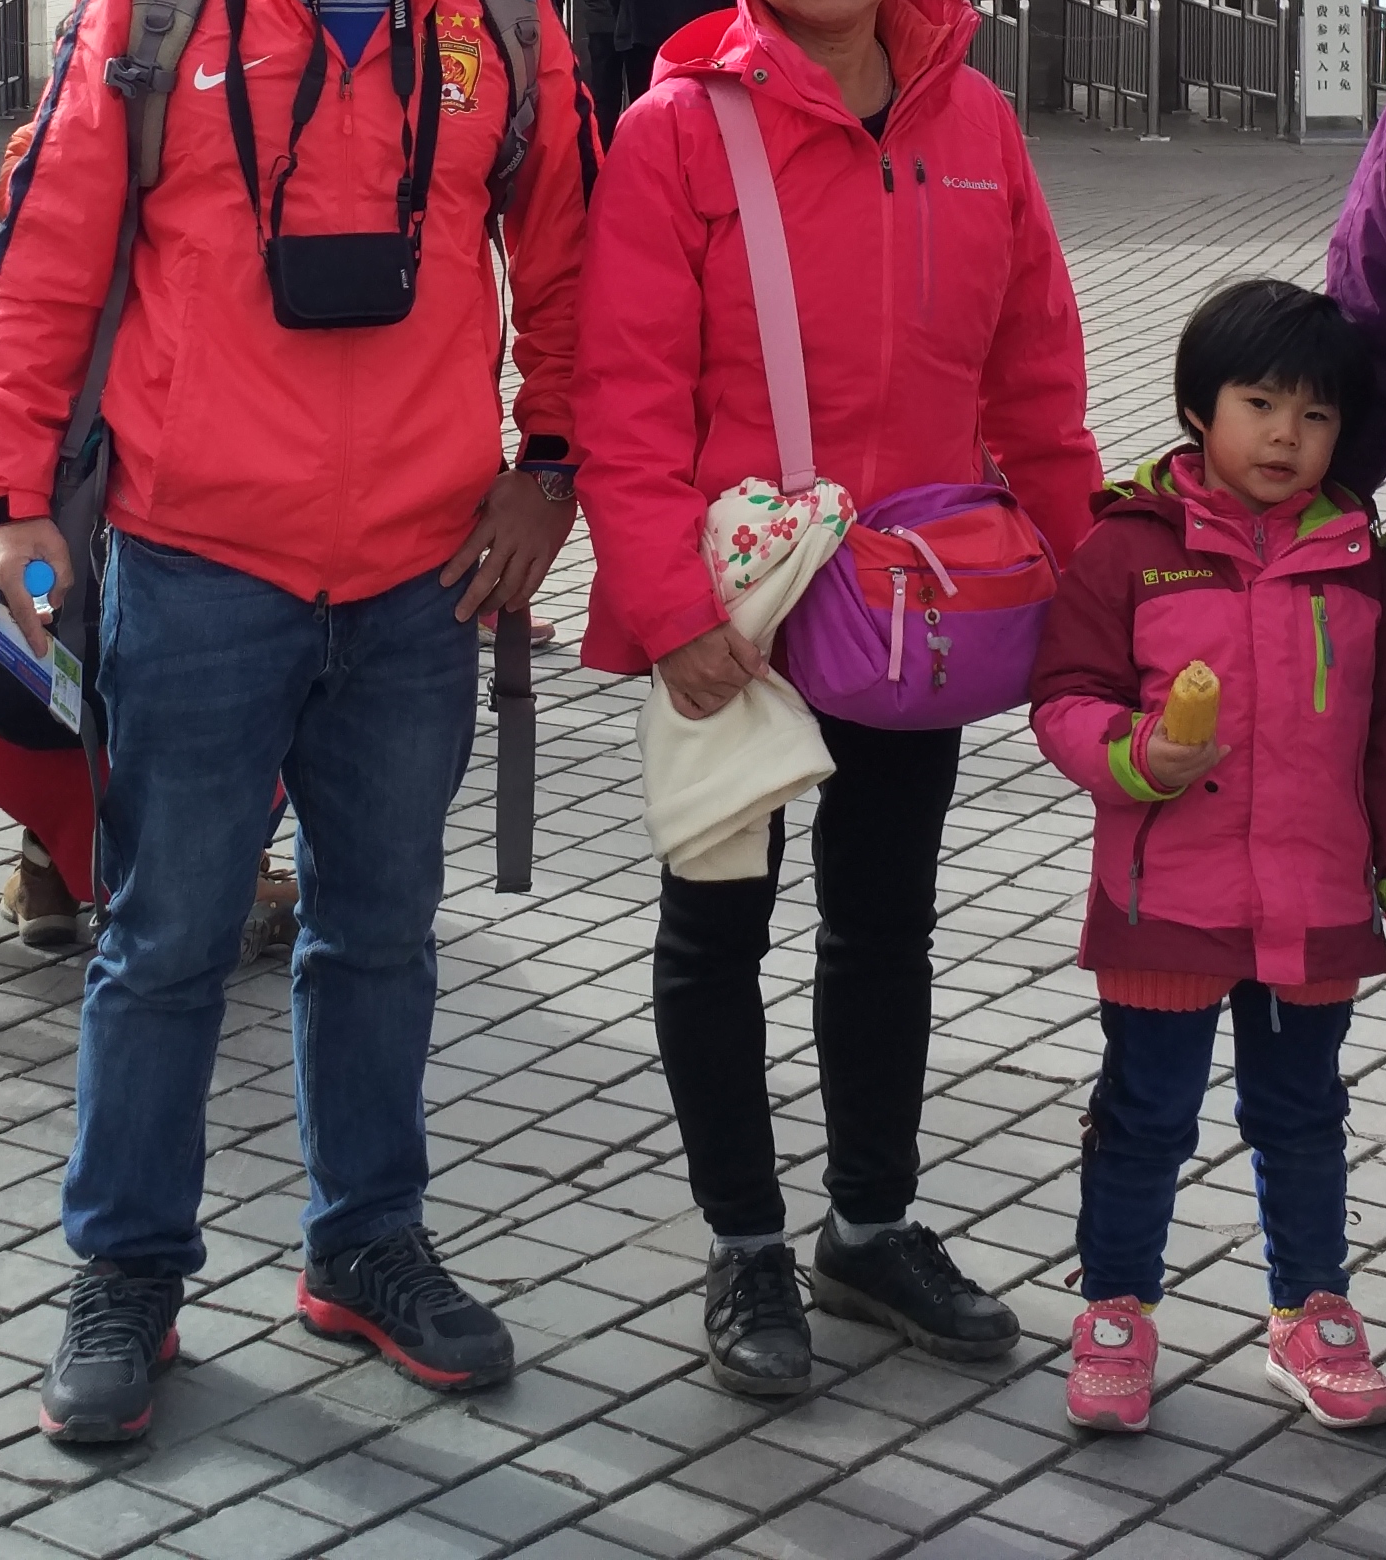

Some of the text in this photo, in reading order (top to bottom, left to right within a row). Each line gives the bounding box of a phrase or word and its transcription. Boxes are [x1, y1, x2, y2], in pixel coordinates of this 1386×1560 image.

[1338, 4, 1351, 91] 残疾人及免
[952, 177, 998, 190] Columbia
[1161, 569, 1213, 582] TOREAD
